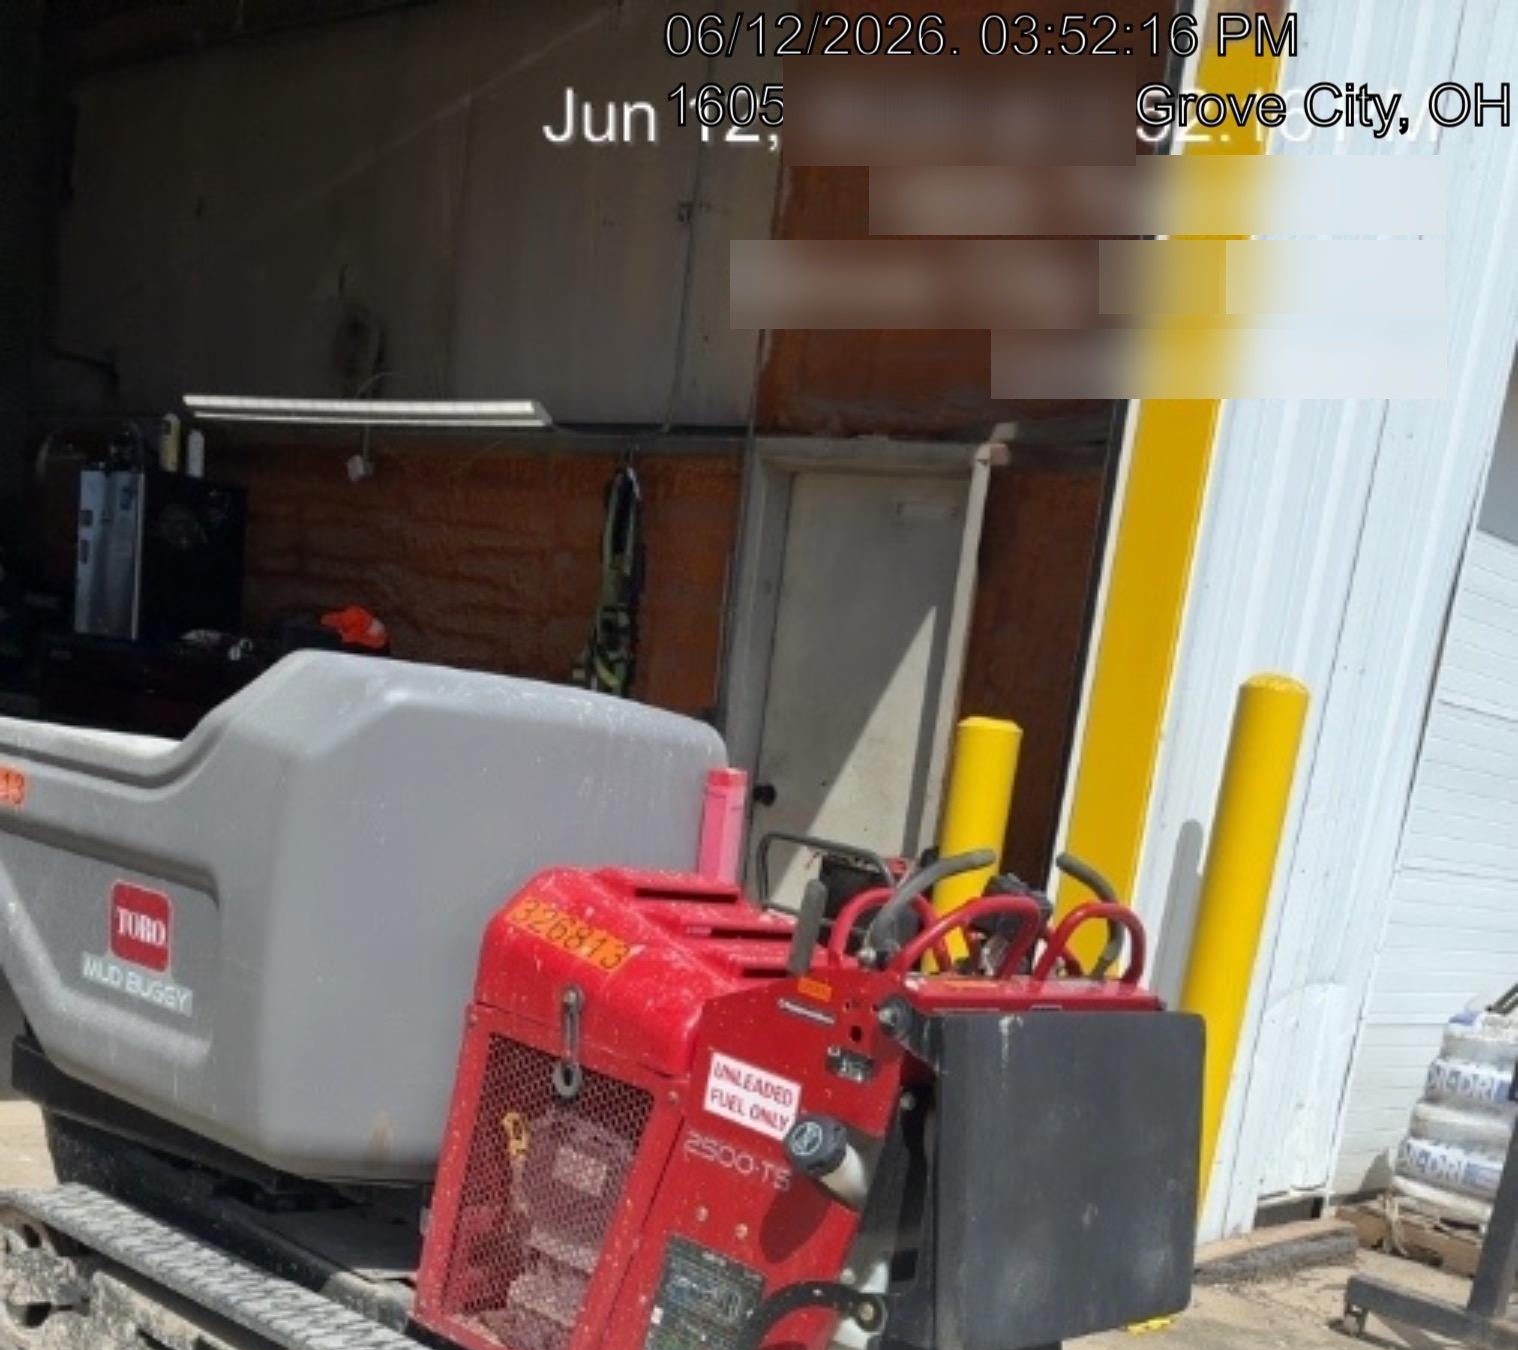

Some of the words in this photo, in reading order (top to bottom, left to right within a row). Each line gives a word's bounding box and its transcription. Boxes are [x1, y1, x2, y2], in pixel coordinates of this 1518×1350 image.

[117, 906, 166, 946] TORO
[82, 954, 123, 988] MUD
[713, 1061, 793, 1106] UNLEADED
[709, 1087, 746, 1117] FUEL
[749, 1103, 790, 1132] ONLY
